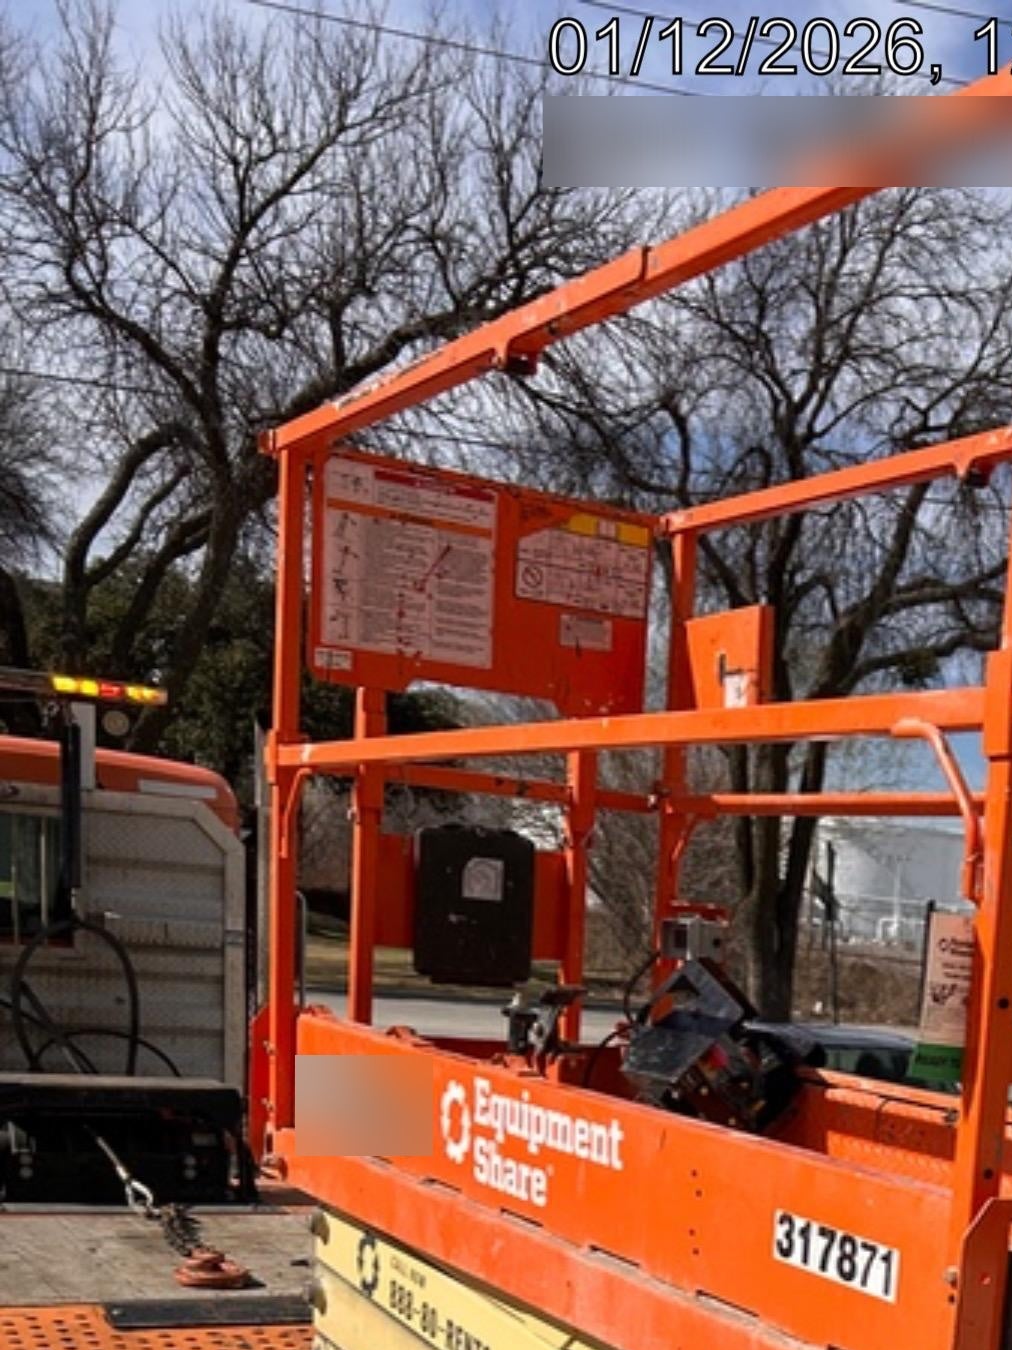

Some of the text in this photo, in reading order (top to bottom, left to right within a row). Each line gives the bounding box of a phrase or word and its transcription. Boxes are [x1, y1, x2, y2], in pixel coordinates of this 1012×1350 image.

[472, 1076, 625, 1170] Equipment
[472, 1135, 548, 1207] Share
[776, 1212, 893, 1297] 317871
